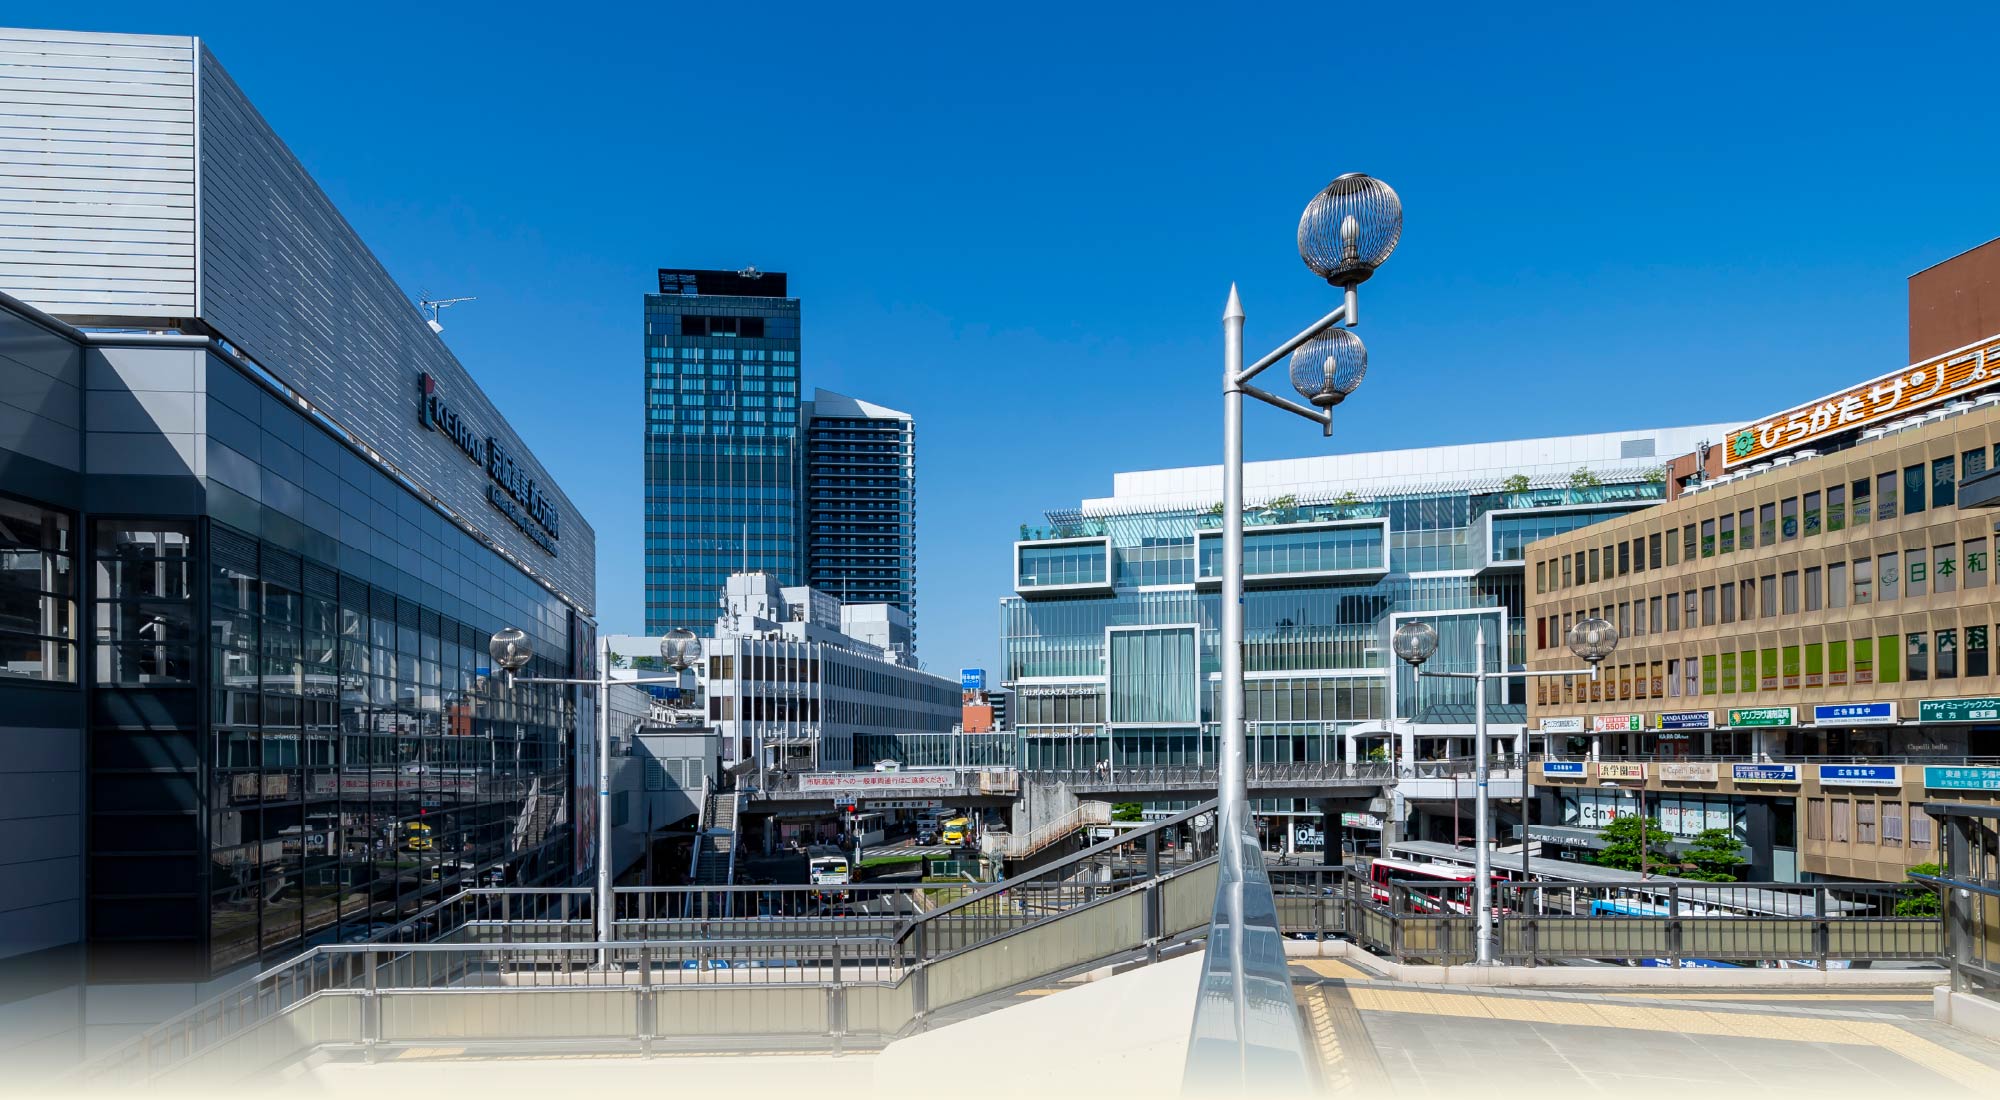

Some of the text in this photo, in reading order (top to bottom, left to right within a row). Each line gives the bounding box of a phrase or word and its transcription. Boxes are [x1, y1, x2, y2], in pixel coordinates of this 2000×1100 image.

[436, 397, 483, 465] KEIHAN
[493, 441, 528, 506] 京阪電車
[1911, 549, 2000, 582] 日本和
[1682, 713, 1708, 722] DIAMOND
[1833, 707, 1870, 716] 広告募集中
[1601, 764, 1628, 776] 浜学園
